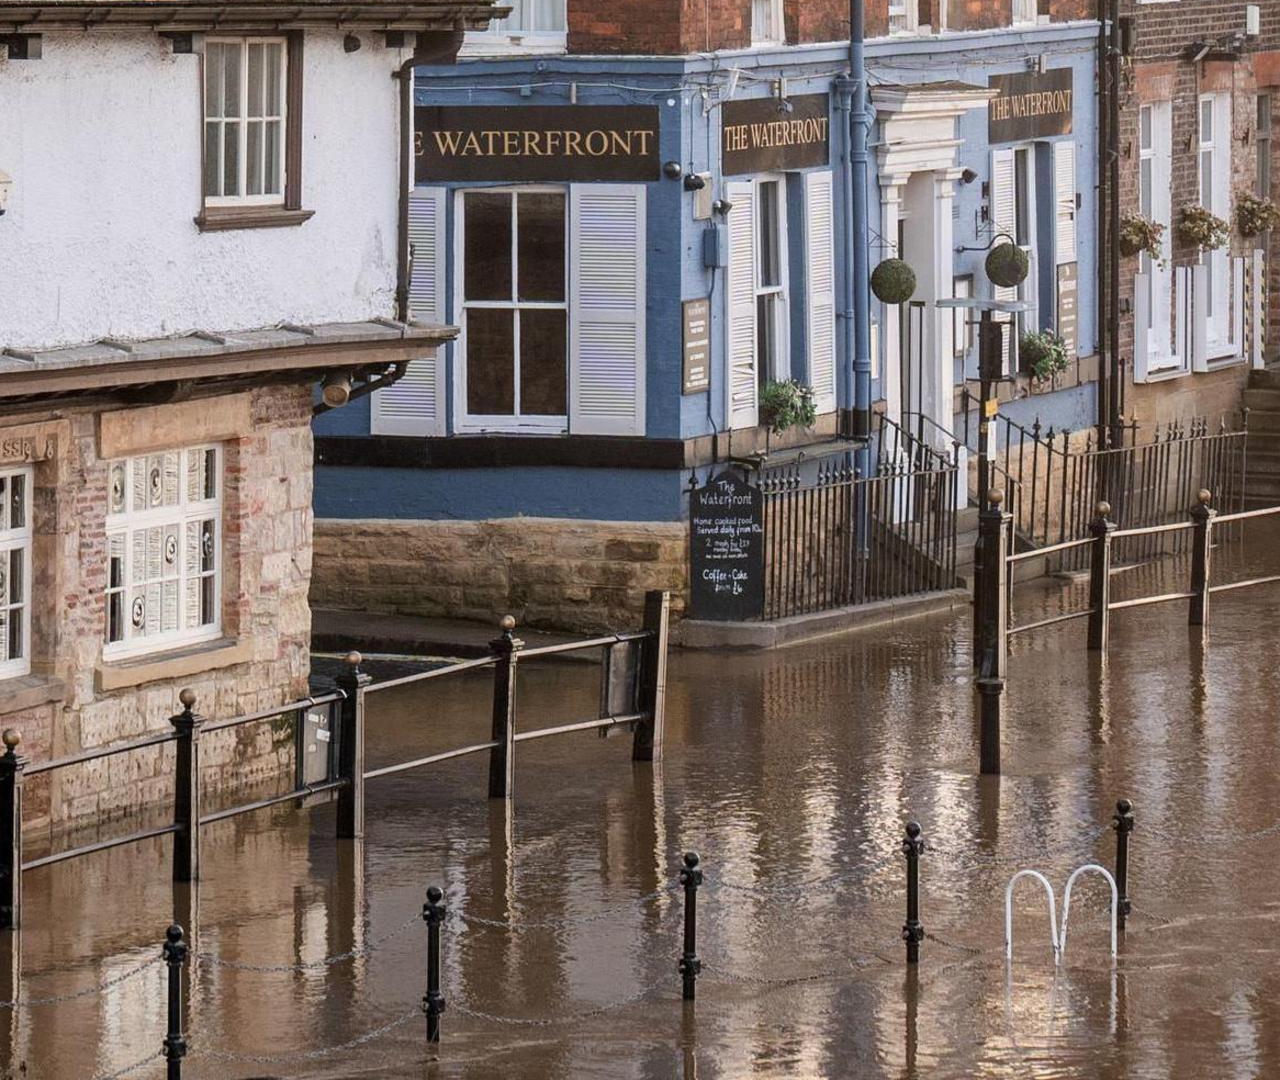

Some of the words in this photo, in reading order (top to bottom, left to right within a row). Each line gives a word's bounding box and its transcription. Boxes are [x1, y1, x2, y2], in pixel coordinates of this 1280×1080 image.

[990, 96, 1010, 121] THE
[1012, 89, 1072, 118] WATERFRONT
[724, 125, 749, 152] THE
[751, 117, 828, 149] WATERFRONT
[433, 130, 653, 156] WATERFRONT
[717, 480, 735, 491] The
[700, 491, 752, 509] Waterfront
[693, 517, 712, 525] Home
[714, 517, 736, 525] cooked
[738, 514, 752, 527] food
[697, 526, 718, 534] Served
[720, 525, 735, 538] daily
[736, 526, 751, 536] from
[705, 538, 712, 547] 2
[702, 568, 727, 582] Coffee
[732, 568, 748, 580] Cake
[715, 584, 731, 592] from
